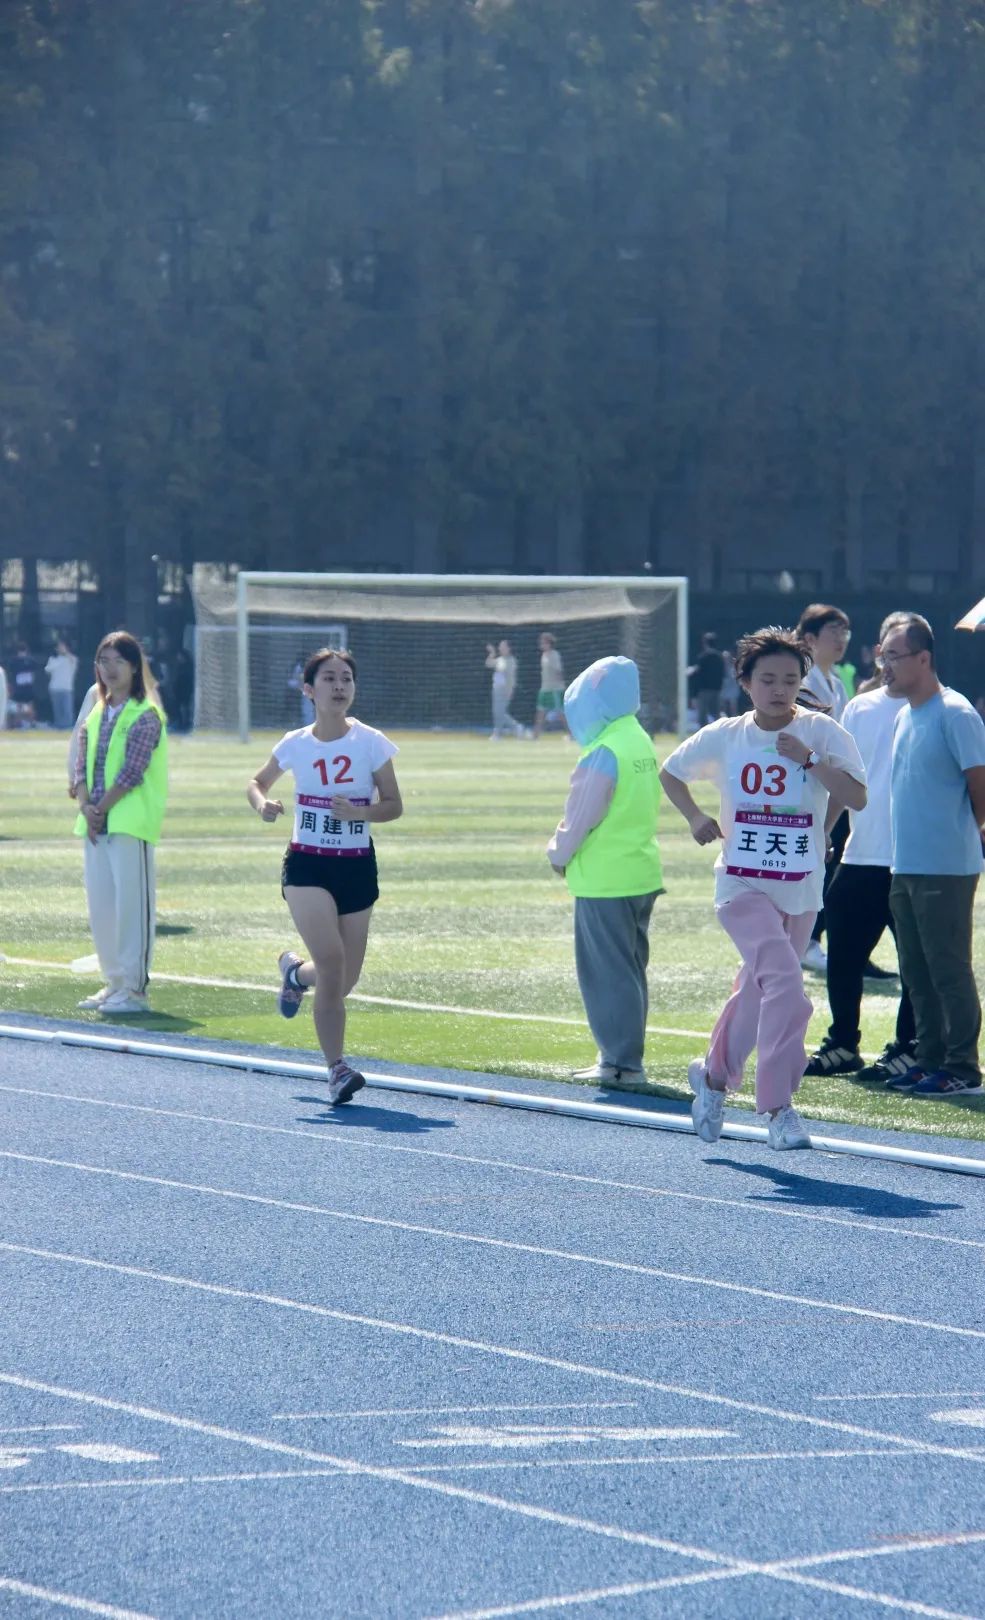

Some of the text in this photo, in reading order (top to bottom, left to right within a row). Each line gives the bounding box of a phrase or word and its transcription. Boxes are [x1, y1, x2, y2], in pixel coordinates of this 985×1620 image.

[313, 755, 353, 785] 12
[741, 762, 787, 796] 03
[762, 859, 787, 868] 0619
